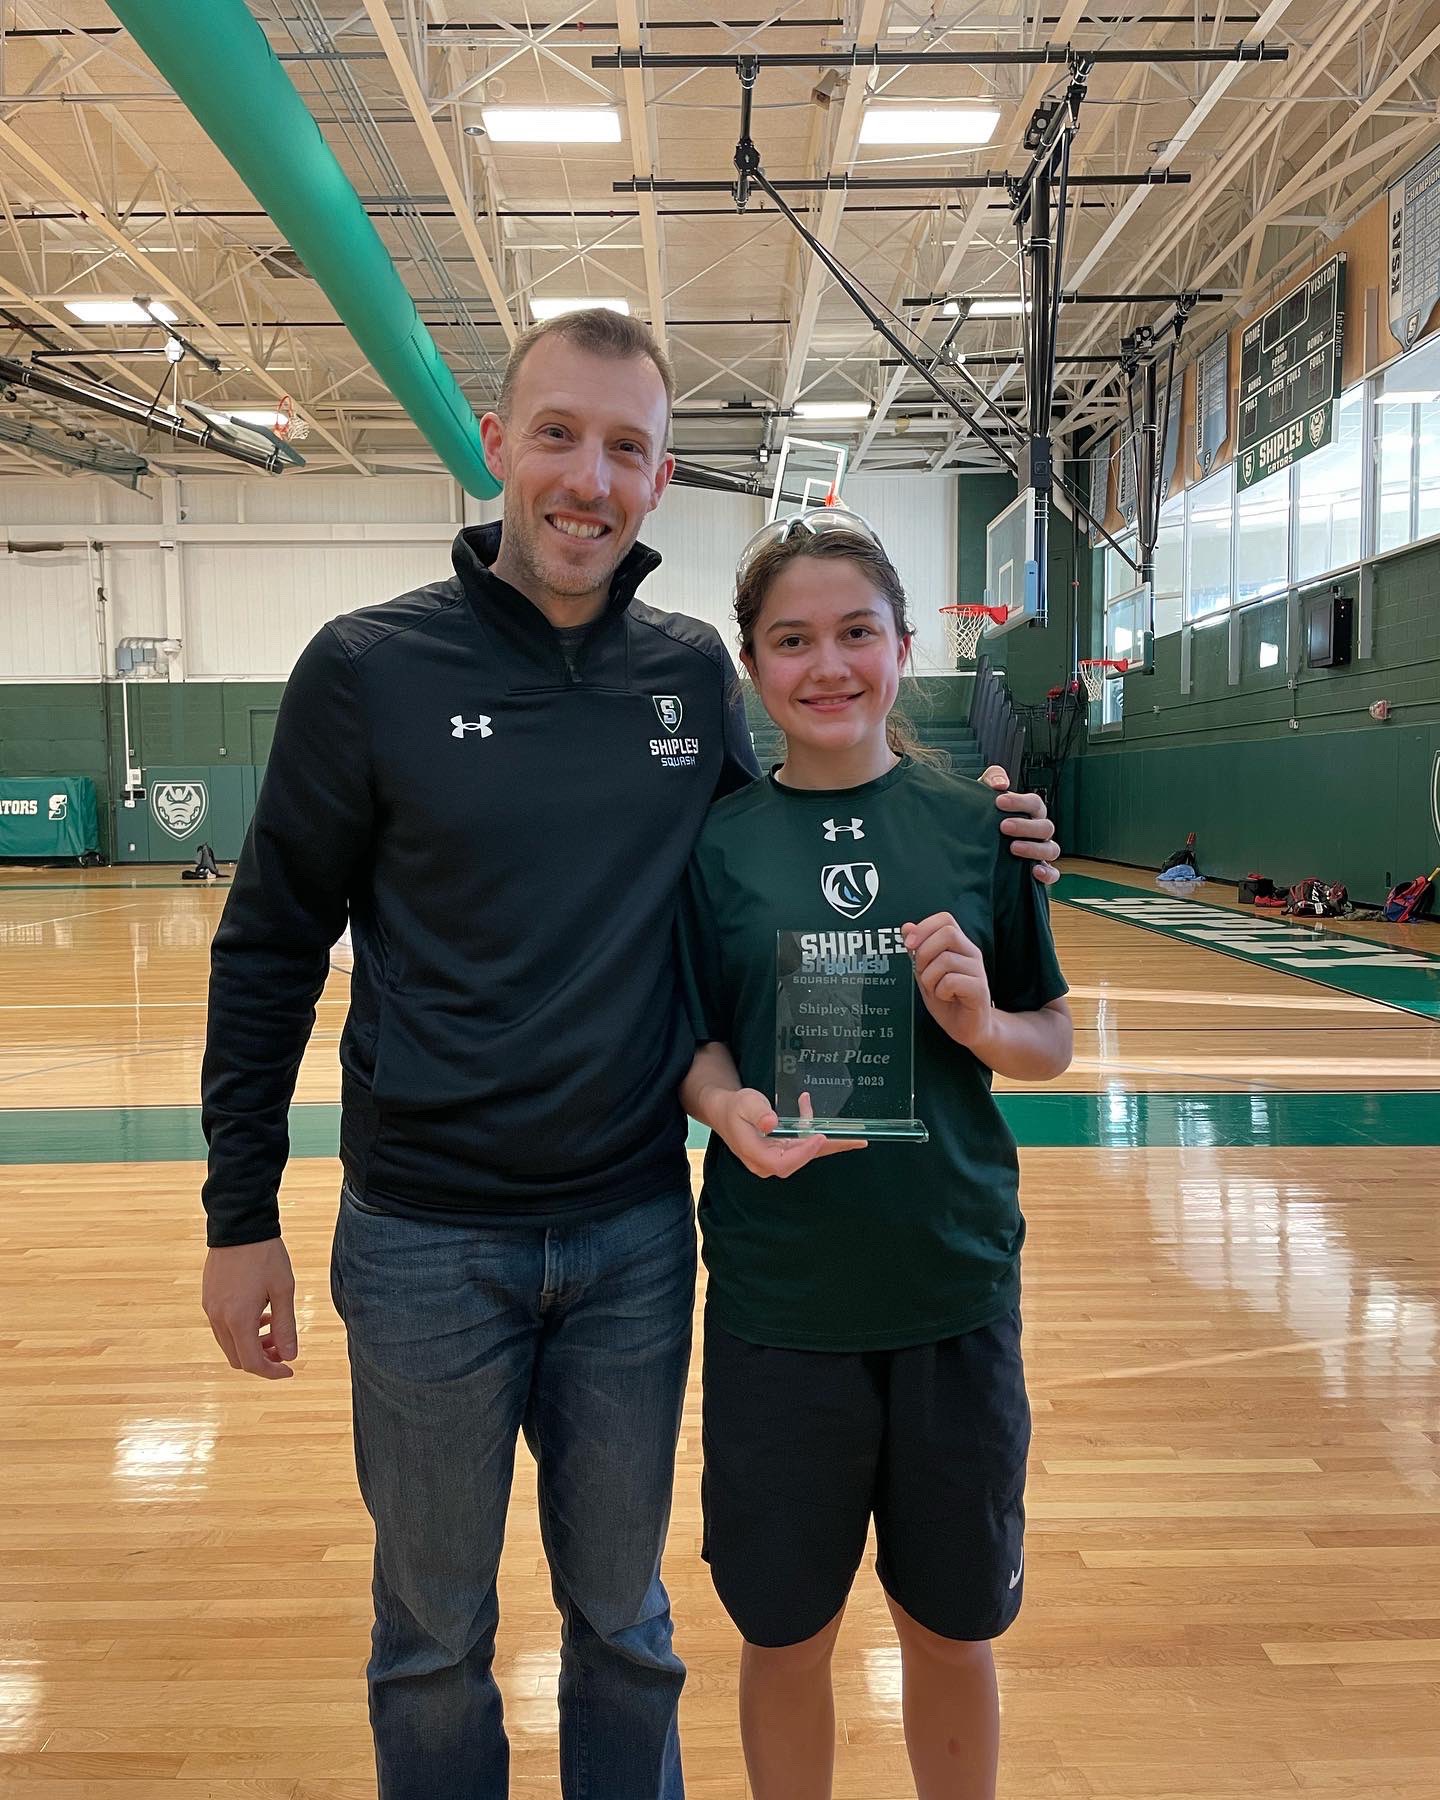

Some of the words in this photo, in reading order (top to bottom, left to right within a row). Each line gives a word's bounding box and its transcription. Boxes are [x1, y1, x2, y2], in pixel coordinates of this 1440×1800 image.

[1391, 210, 1401, 295] KSAC
[1310, 264, 1336, 294] VISITOR
[1244, 324, 1261, 348] HOME
[1307, 331, 1324, 351] BONUS
[1271, 350, 1288, 370] PERIOD
[1309, 351, 1325, 370] FOULS
[1248, 375, 1262, 393] BONUS
[1268, 379, 1284, 398] PLAYER
[1286, 367, 1301, 385] FOULS
[1245, 397, 1258, 413] FOULS
[1259, 420, 1304, 468] SHIPLEY
[1245, 455, 1252, 478] S
[1267, 453, 1294, 475] GATORS
[660, 699, 677, 724] S
[649, 738, 699, 756] SHIPLEY
[661, 756, 696, 767] SQUASH
[0, 800, 38, 815] TORS
[793, 976, 838, 985] SQUASH
[842, 977, 897, 986] ACADEMY
[799, 1002, 848, 1017] Shipley
[851, 1003, 891, 1016] Silver
[794, 1025, 829, 1037] Girls
[832, 1025, 876, 1038] Under
[880, 1027, 894, 1038] 15
[797, 1048, 840, 1063] First
[843, 1049, 890, 1064] Place
[803, 1074, 854, 1088] January
[857, 1075, 885, 1087] 2023
